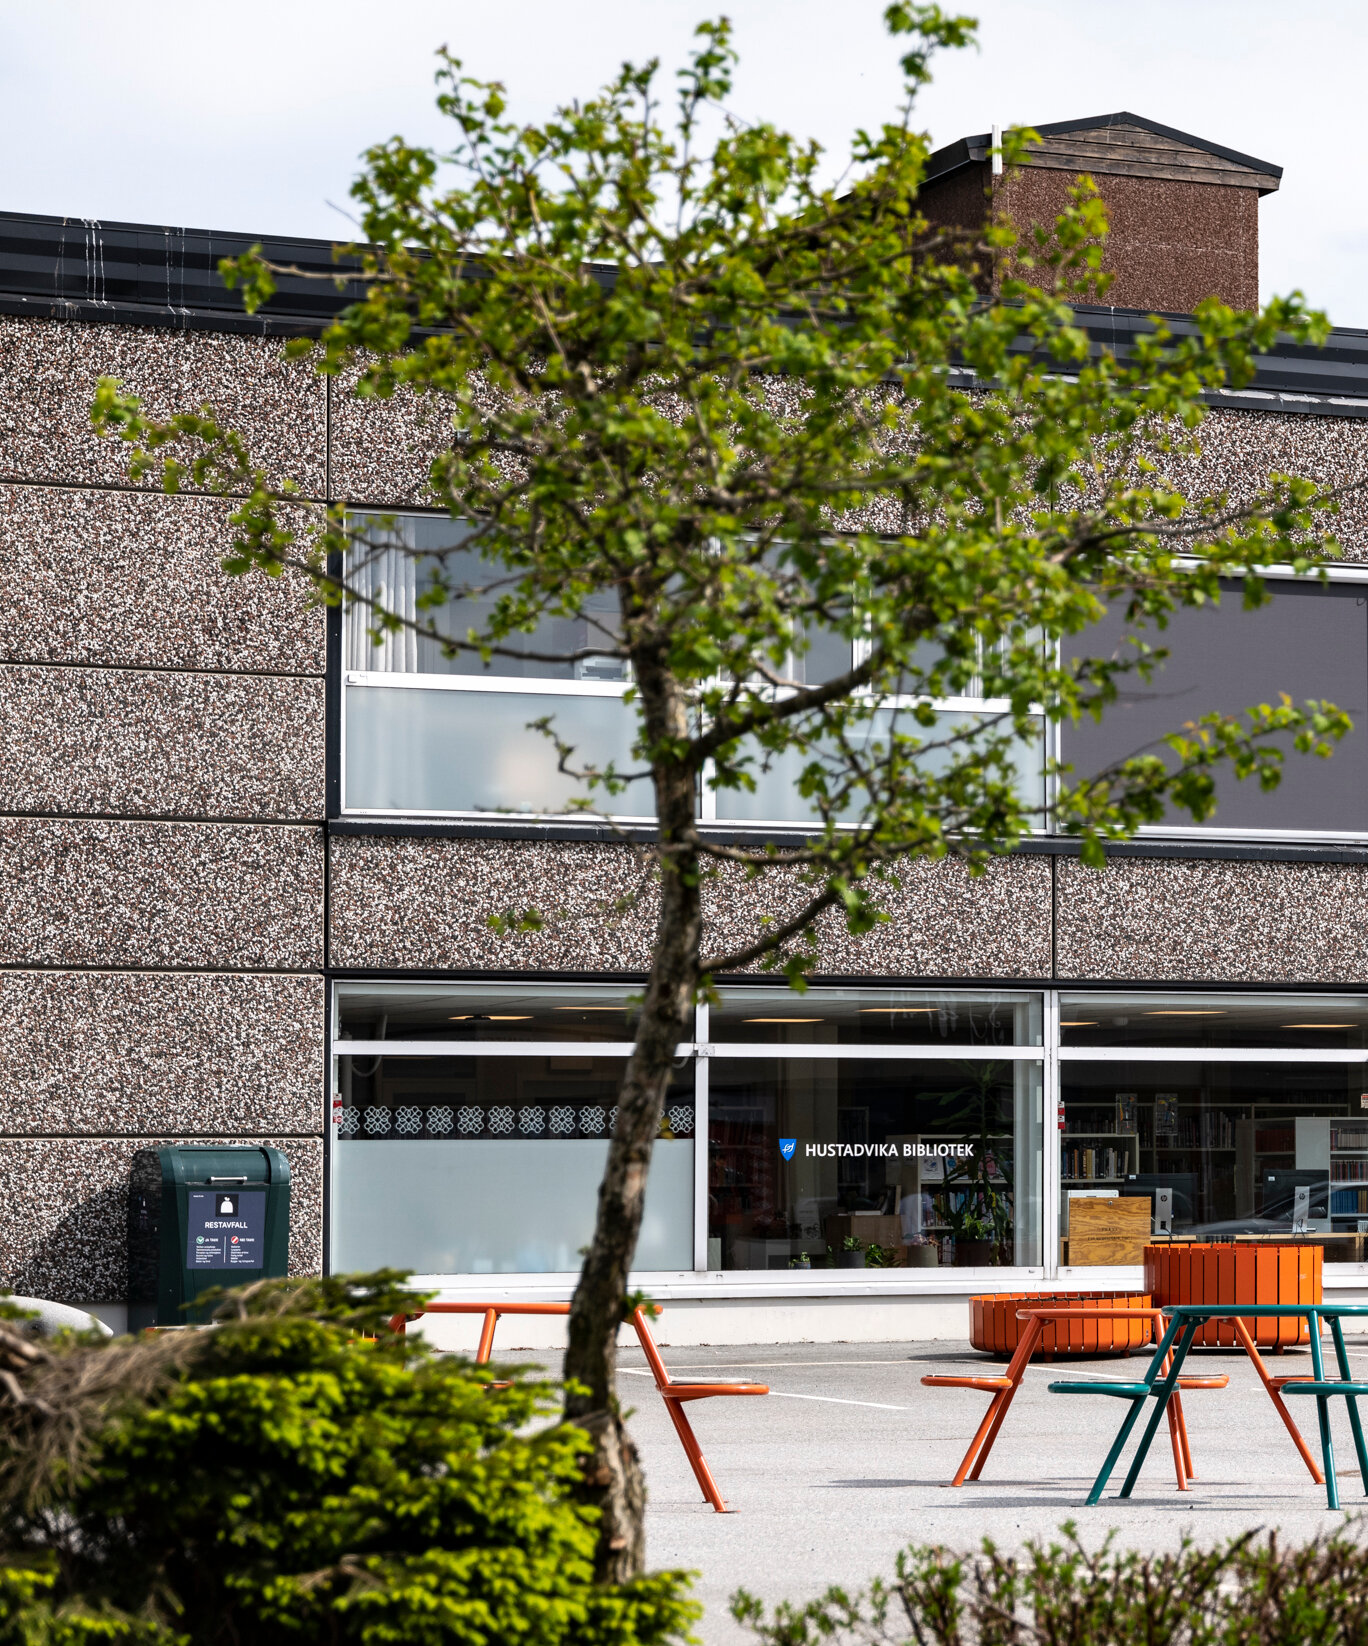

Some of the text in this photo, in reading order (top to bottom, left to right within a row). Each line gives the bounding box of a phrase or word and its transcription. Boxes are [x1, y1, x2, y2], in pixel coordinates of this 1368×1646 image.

[805, 1143, 974, 1157] HUSTADVIKA BIBLIOTEK
[204, 1221, 248, 1229] RESTAVFALL
